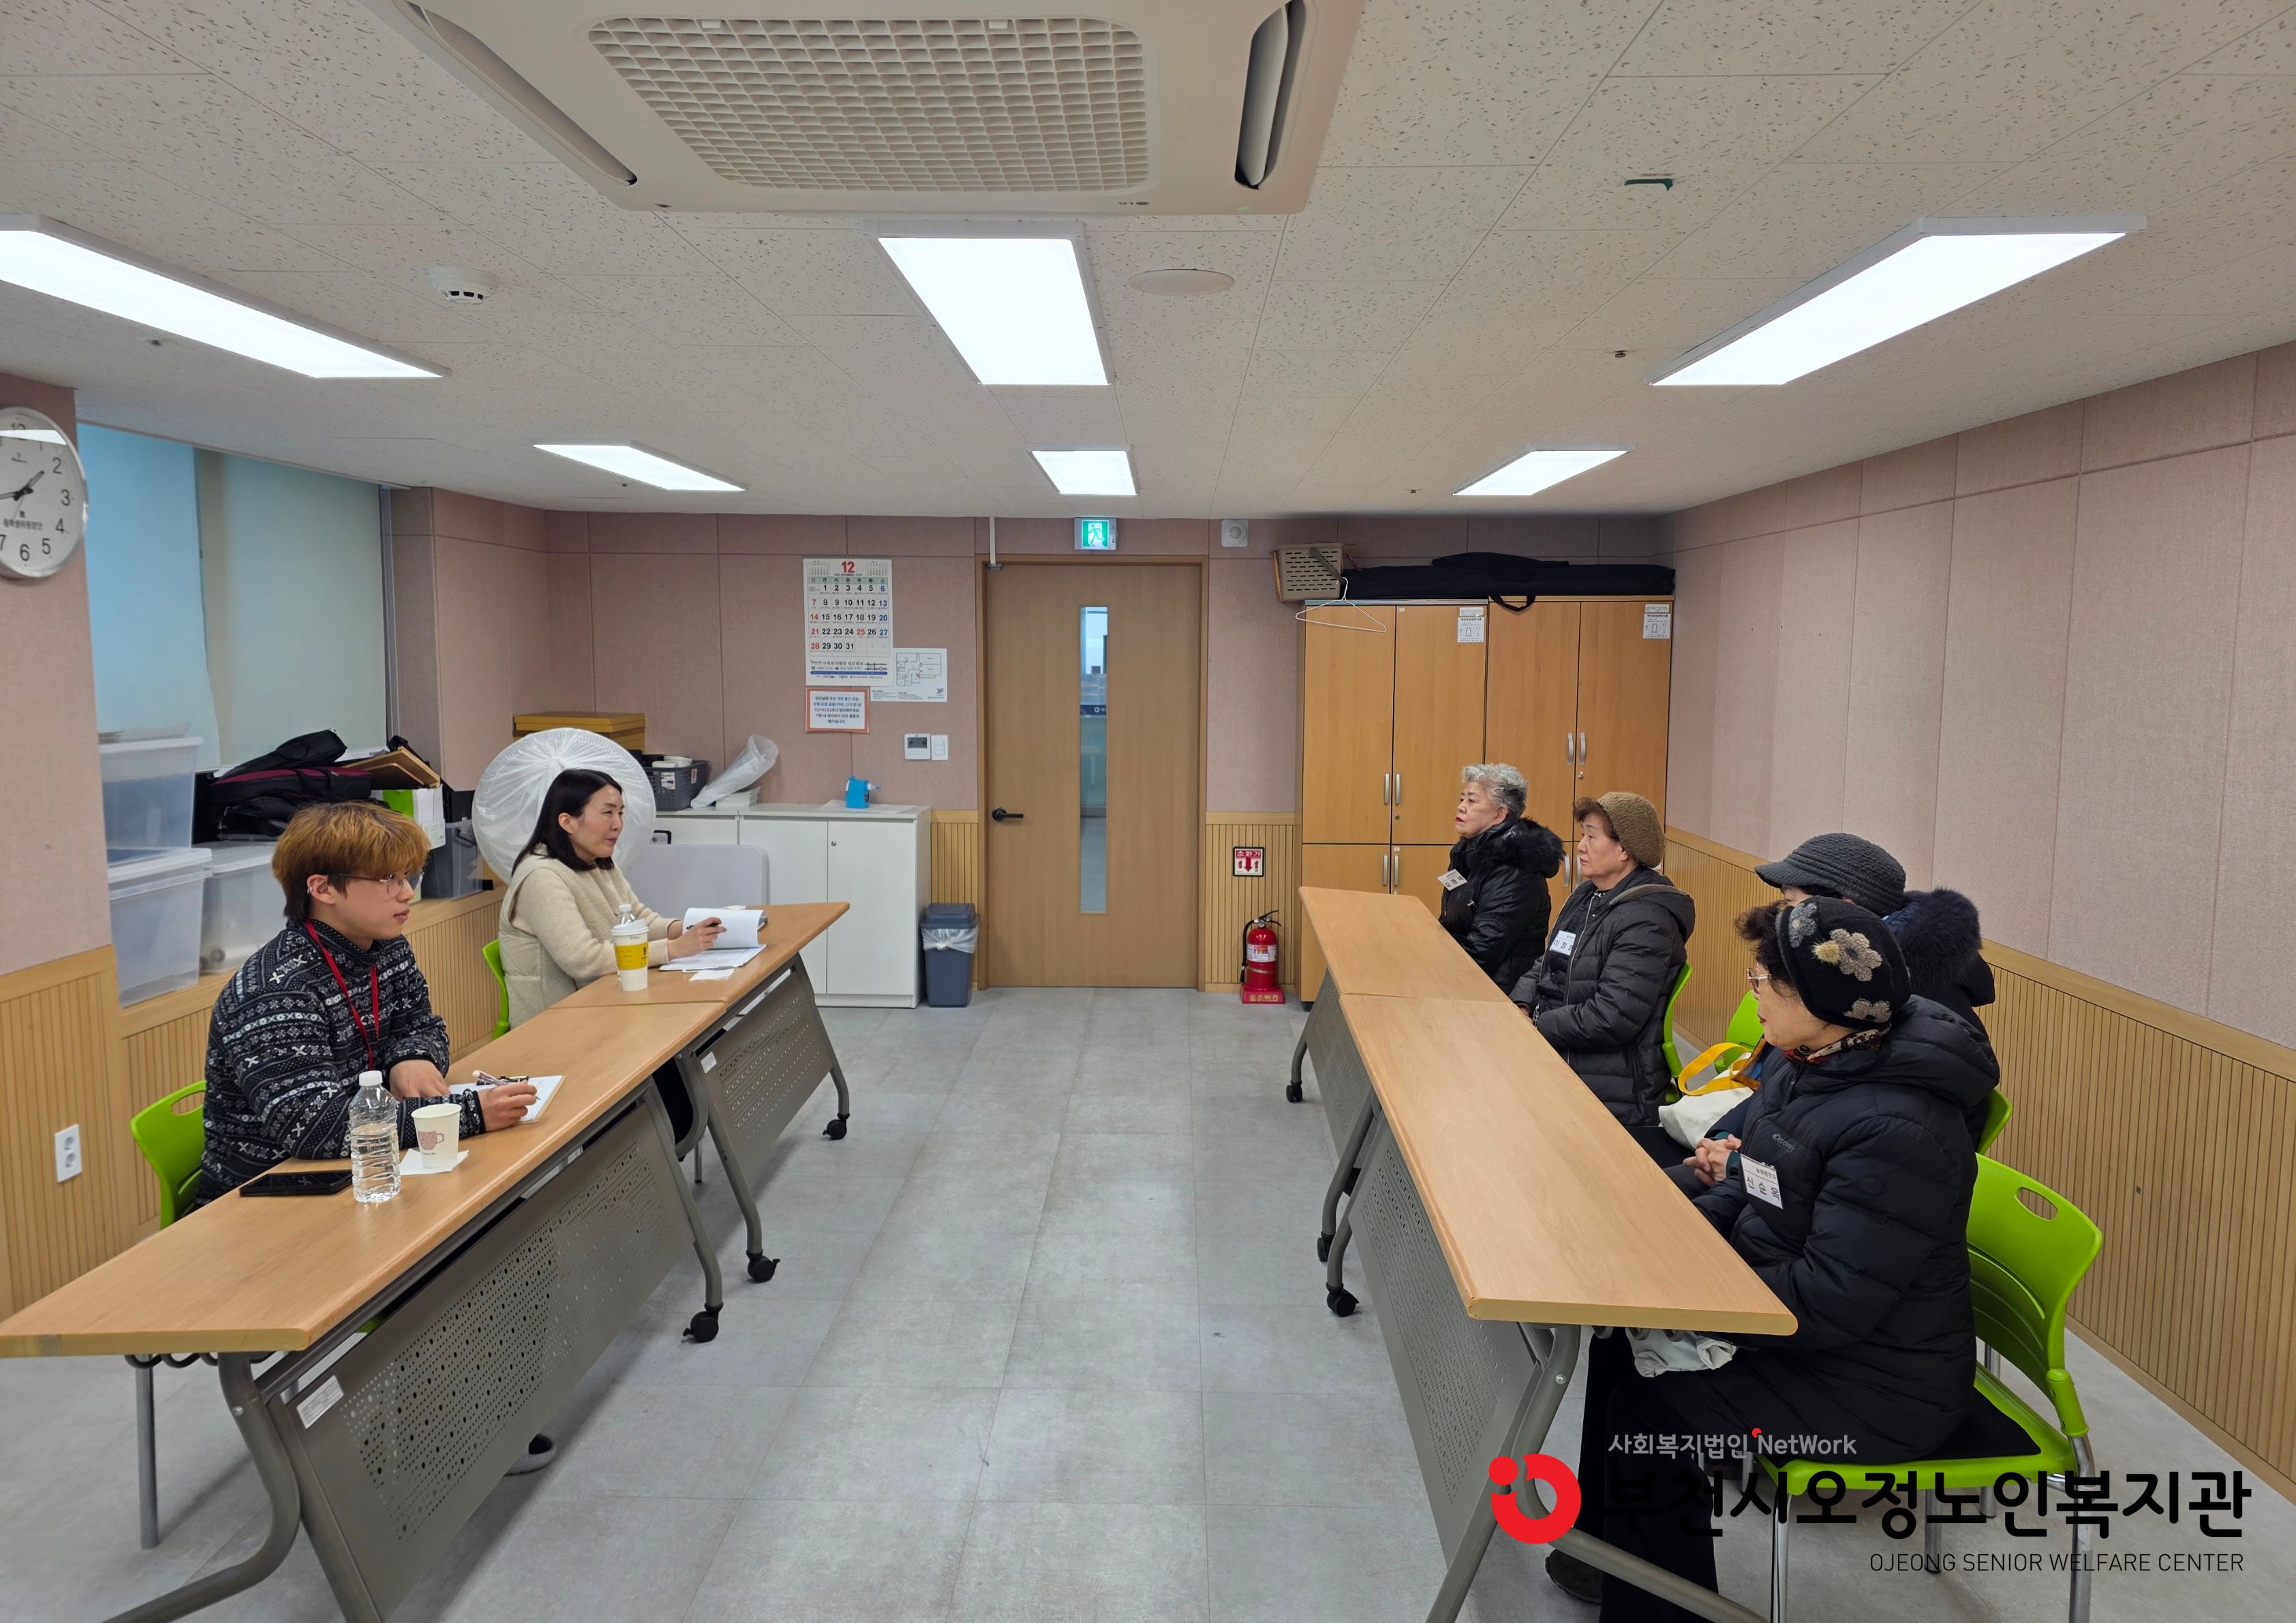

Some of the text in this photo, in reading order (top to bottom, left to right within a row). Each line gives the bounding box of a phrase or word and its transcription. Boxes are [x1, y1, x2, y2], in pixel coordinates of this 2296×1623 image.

[52, 457, 62, 474] 2
[61, 489, 70, 506] 3
[55, 517, 65, 534] 4
[20, 544, 29, 561] 6
[42, 538, 51, 555] 5
[841, 561, 855, 573] 12
